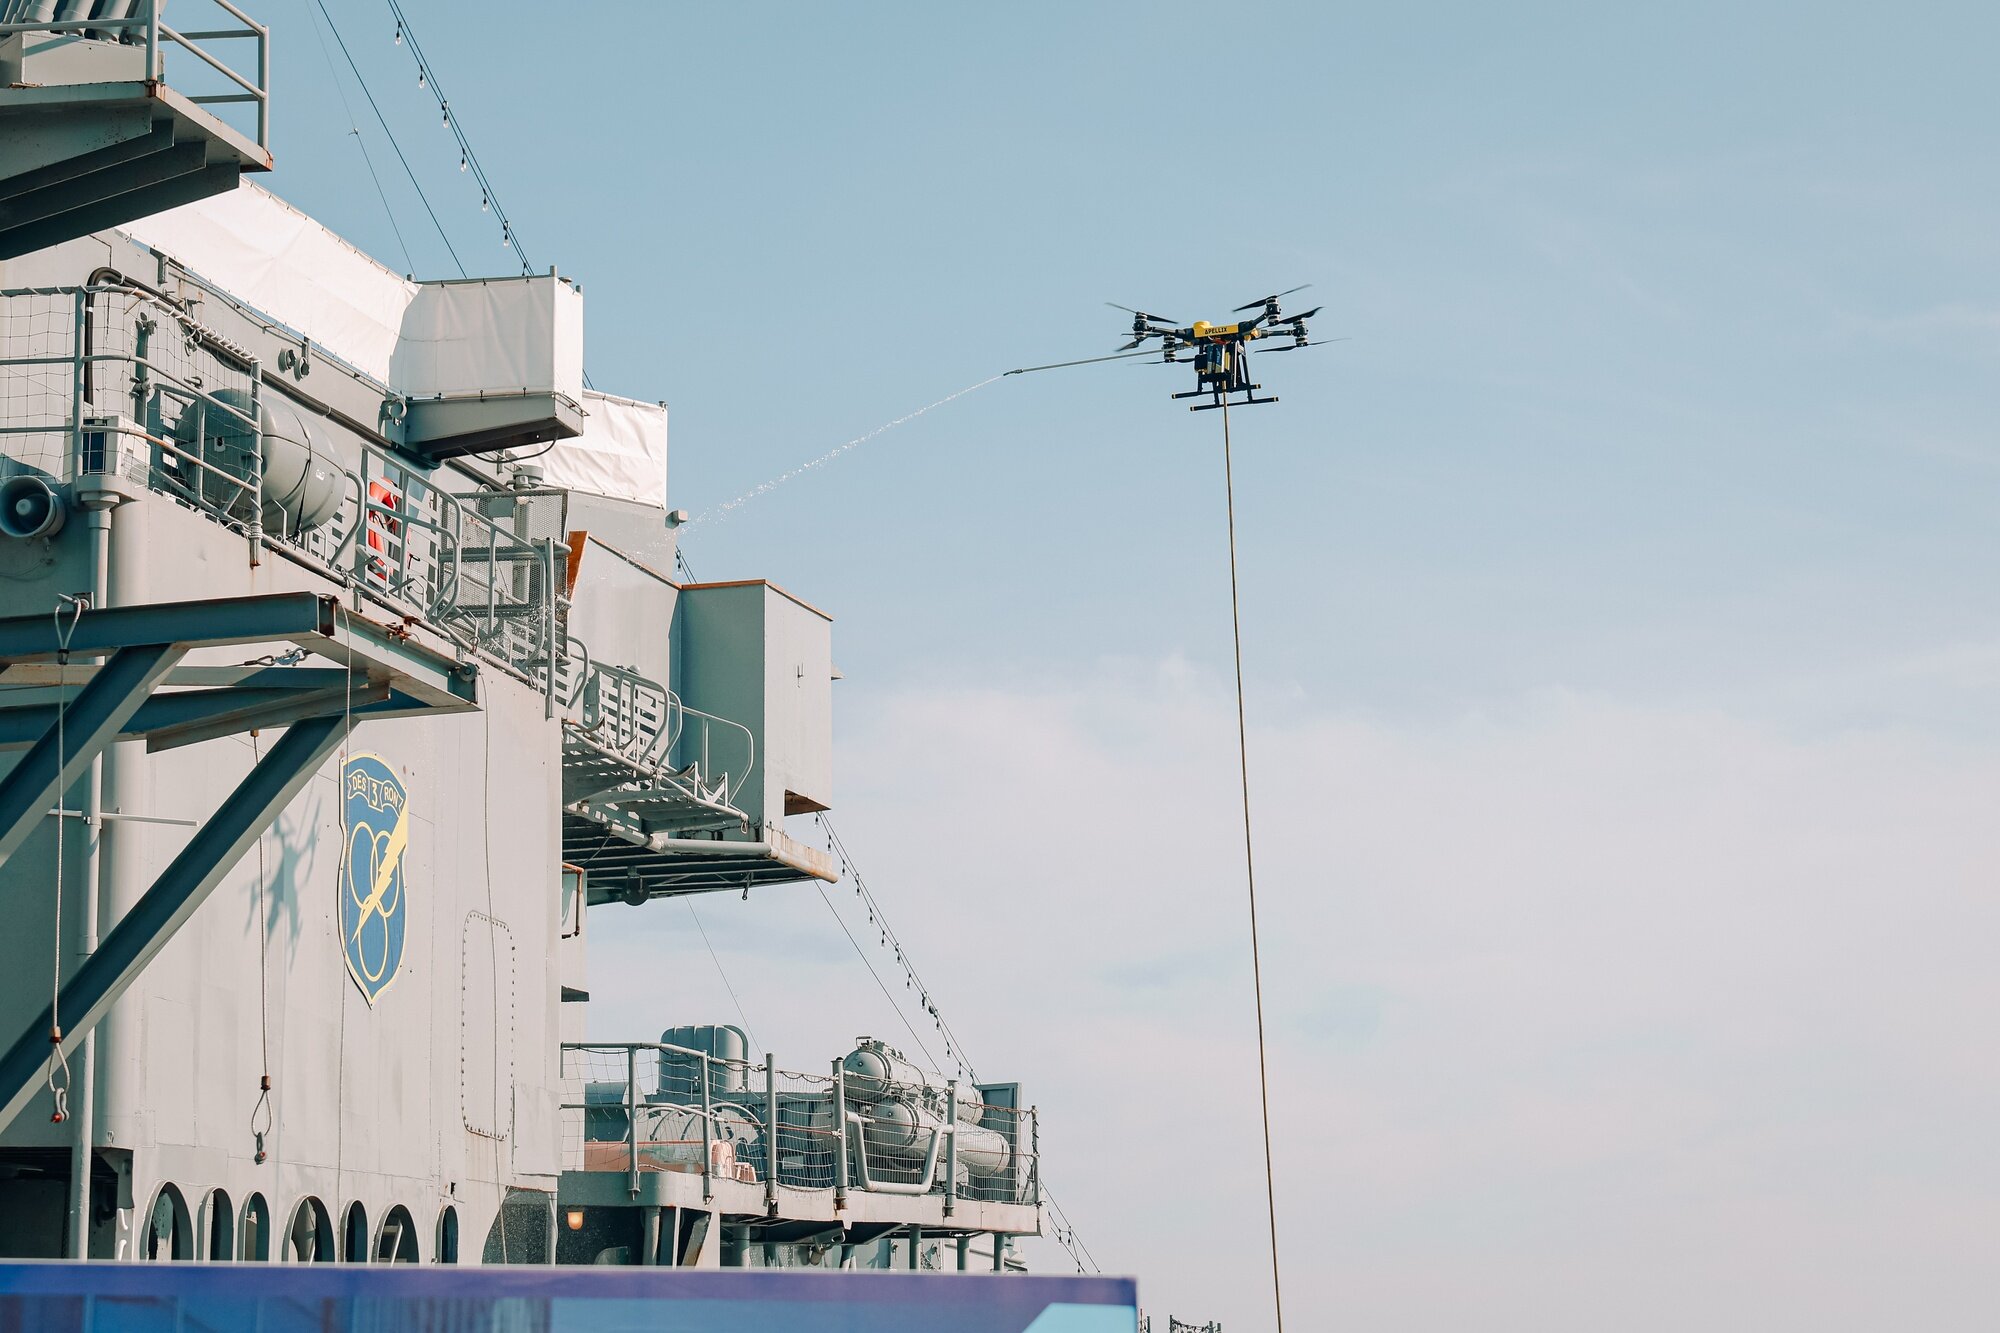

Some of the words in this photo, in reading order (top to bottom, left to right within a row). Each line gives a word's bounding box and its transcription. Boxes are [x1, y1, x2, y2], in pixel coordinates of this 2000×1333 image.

[1204, 327, 1228, 335] APELLIX
[352, 774, 367, 792] DES
[371, 782, 378, 807] 3
[384, 786, 399, 808] RON
